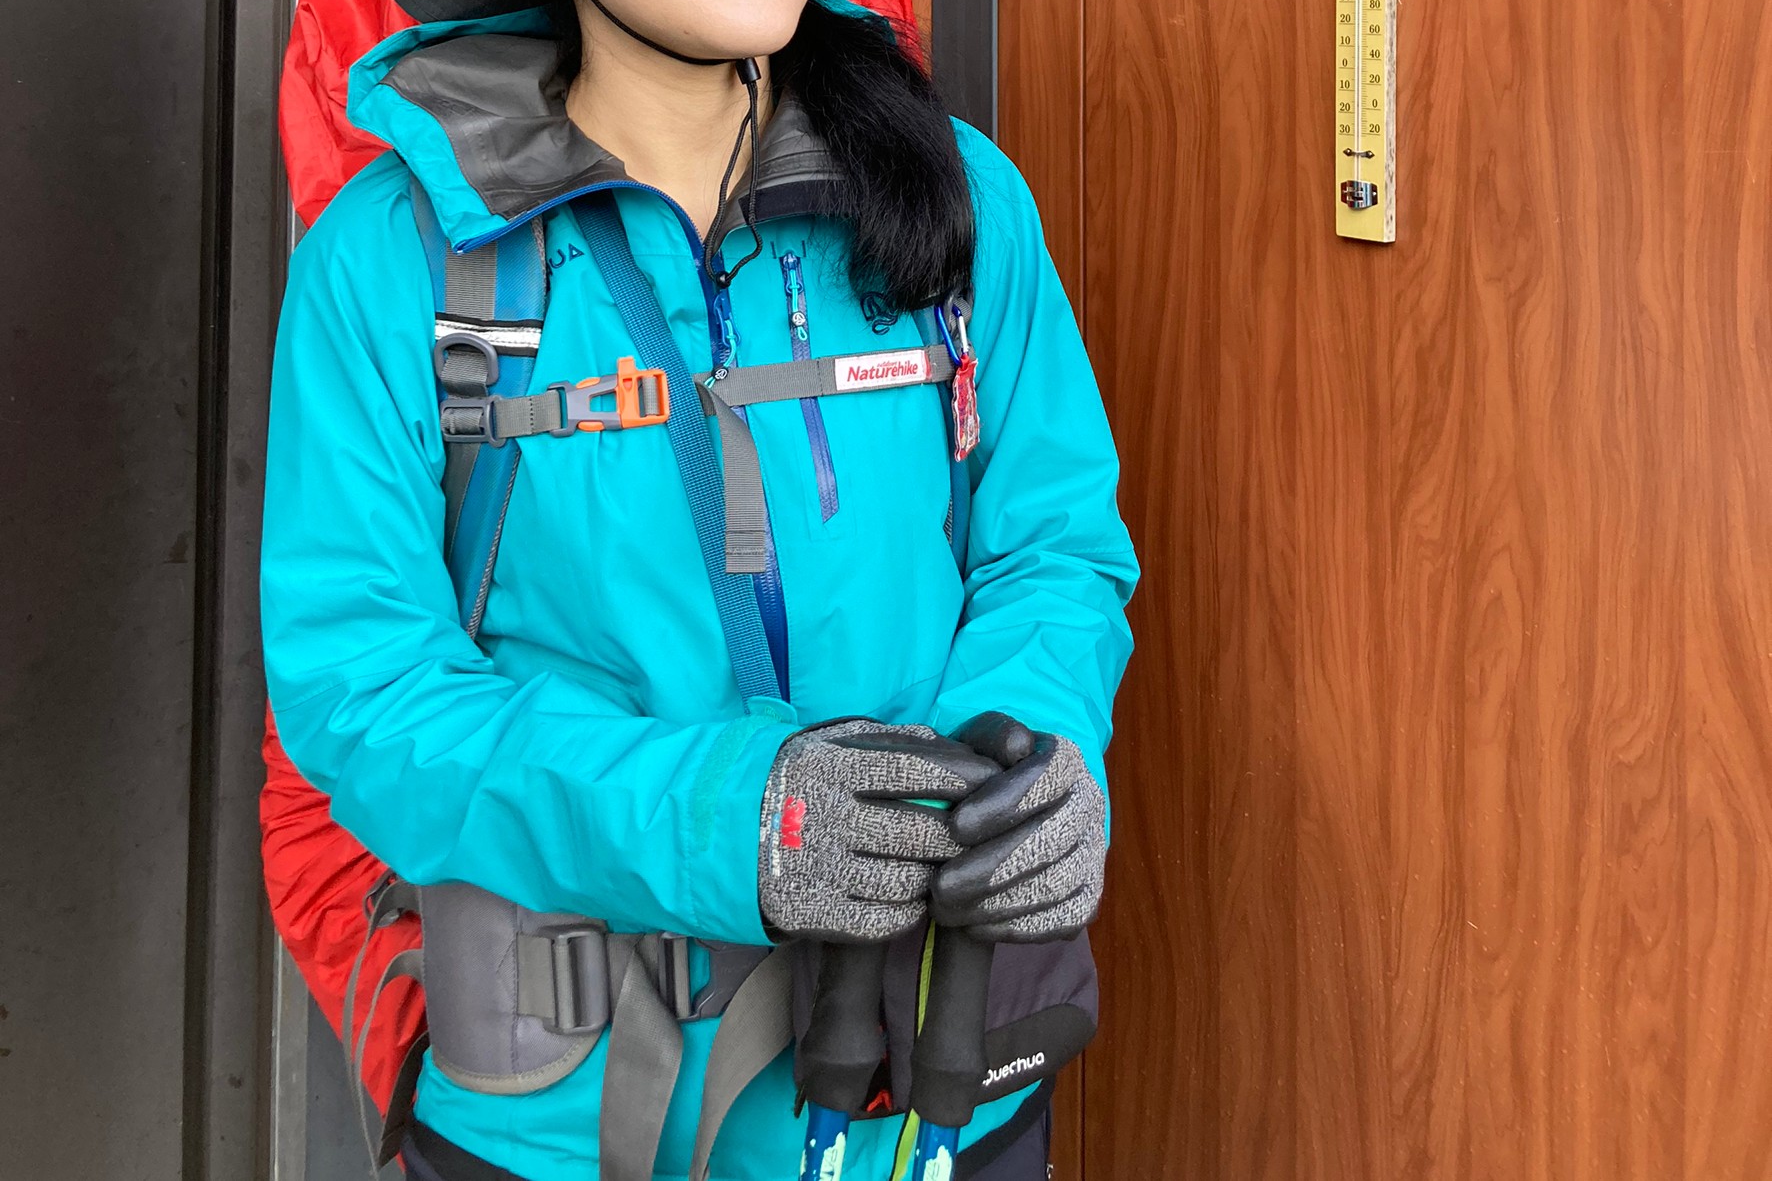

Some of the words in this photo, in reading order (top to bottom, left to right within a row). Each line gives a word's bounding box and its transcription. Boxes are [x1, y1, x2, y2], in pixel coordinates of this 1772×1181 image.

[1369, 0, 1380, 8] 80
[1340, 14, 1351, 23] 20
[1369, 25, 1380, 33] 60
[1340, 36, 1351, 45] 10
[1369, 50, 1380, 58] 40
[1342, 58, 1348, 67] 0
[1369, 74, 1380, 83] 20
[1340, 80, 1350, 89] 10
[1340, 102, 1350, 111] 20
[1372, 99, 1378, 108] 0
[1340, 124, 1350, 133] 30
[1369, 124, 1380, 133] 20
[847, 360, 918, 382] Naturehike
